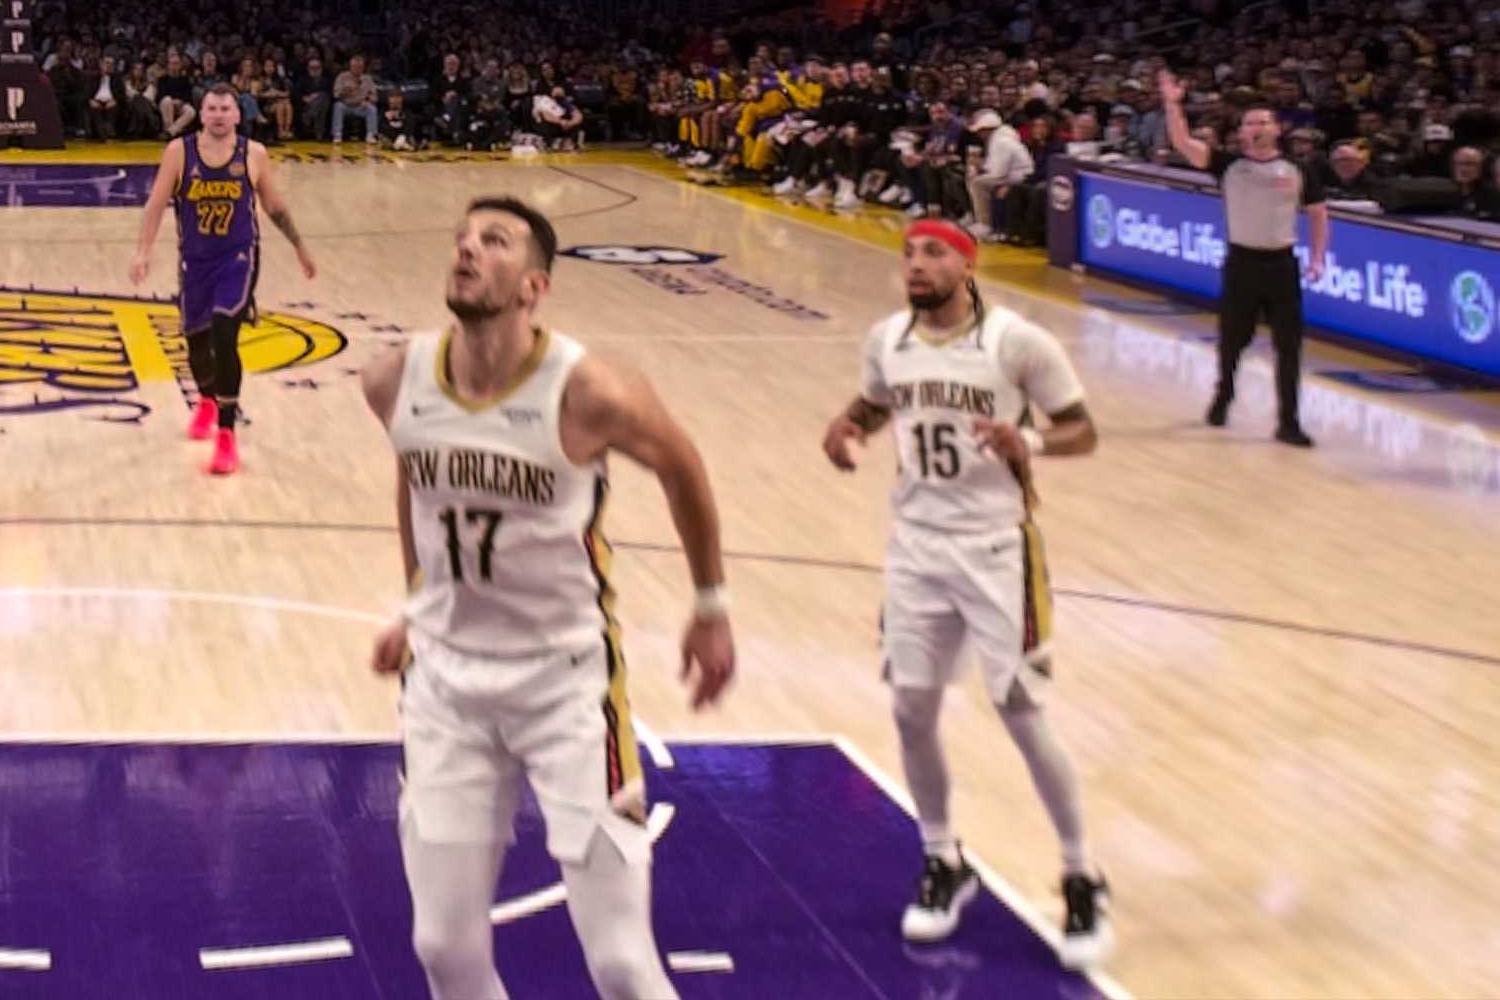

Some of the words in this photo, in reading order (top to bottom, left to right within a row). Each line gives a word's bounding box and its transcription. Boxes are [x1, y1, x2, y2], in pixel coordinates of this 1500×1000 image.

[187, 178, 243, 201] LAKERS
[197, 201, 234, 236] 77
[1116, 207, 1180, 258] Globe
[1181, 221, 1227, 270] Life
[1366, 260, 1428, 318] Life
[449, 449, 556, 505] ORLEANS
[913, 421, 961, 479] 15
[438, 504, 503, 584] 17
